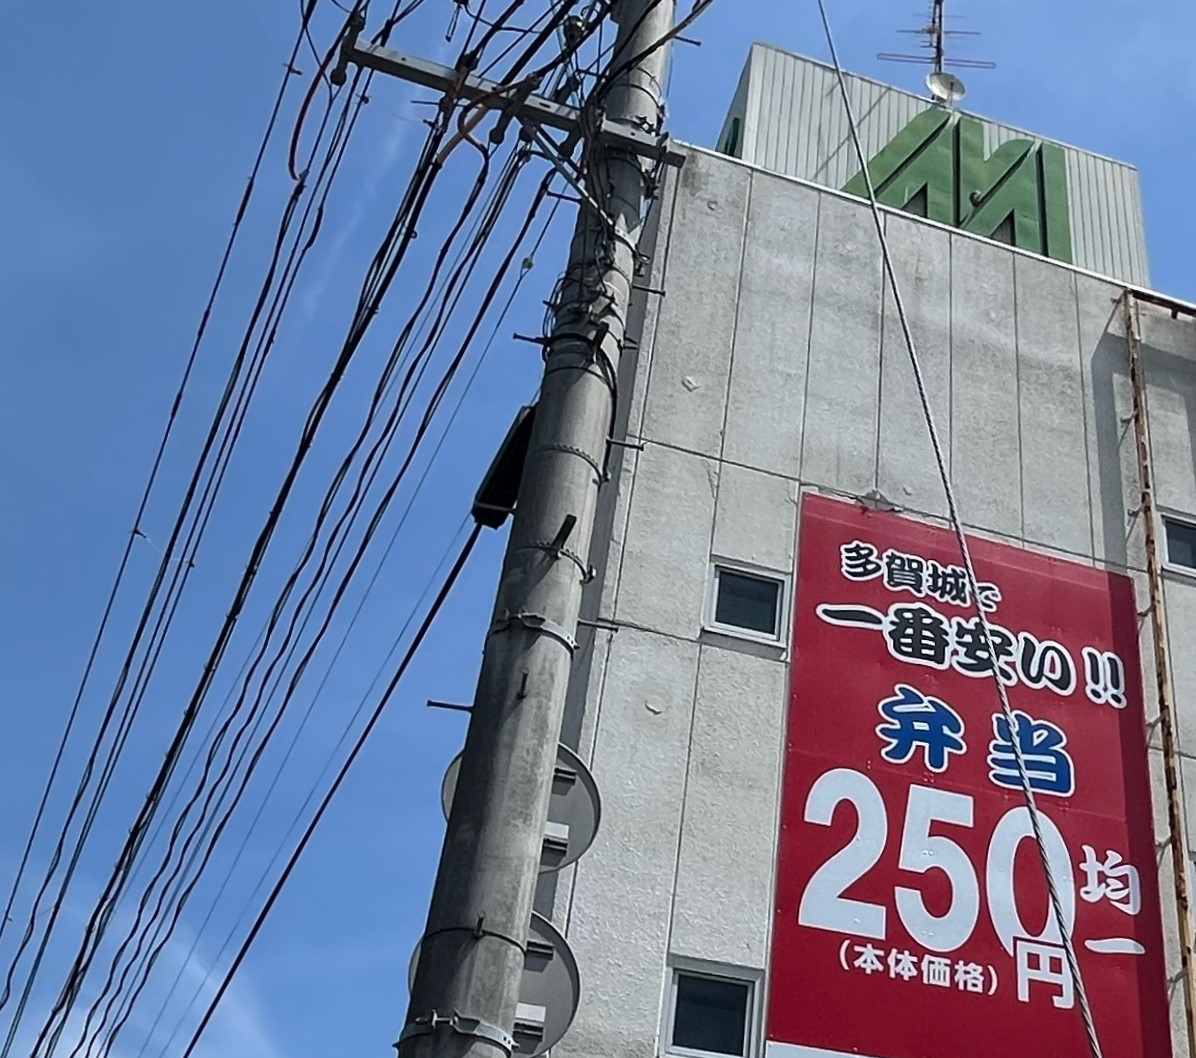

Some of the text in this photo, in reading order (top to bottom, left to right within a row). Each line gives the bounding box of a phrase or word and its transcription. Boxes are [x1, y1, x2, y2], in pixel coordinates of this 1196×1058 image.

[840, 540, 1001, 612] 多賀城で
[876, 684, 1075, 797] 弁当
[798, 768, 1076, 1009] 250 円
[1079, 844, 1146, 955] 均一
[839, 939, 998, 996] (本体価格)
